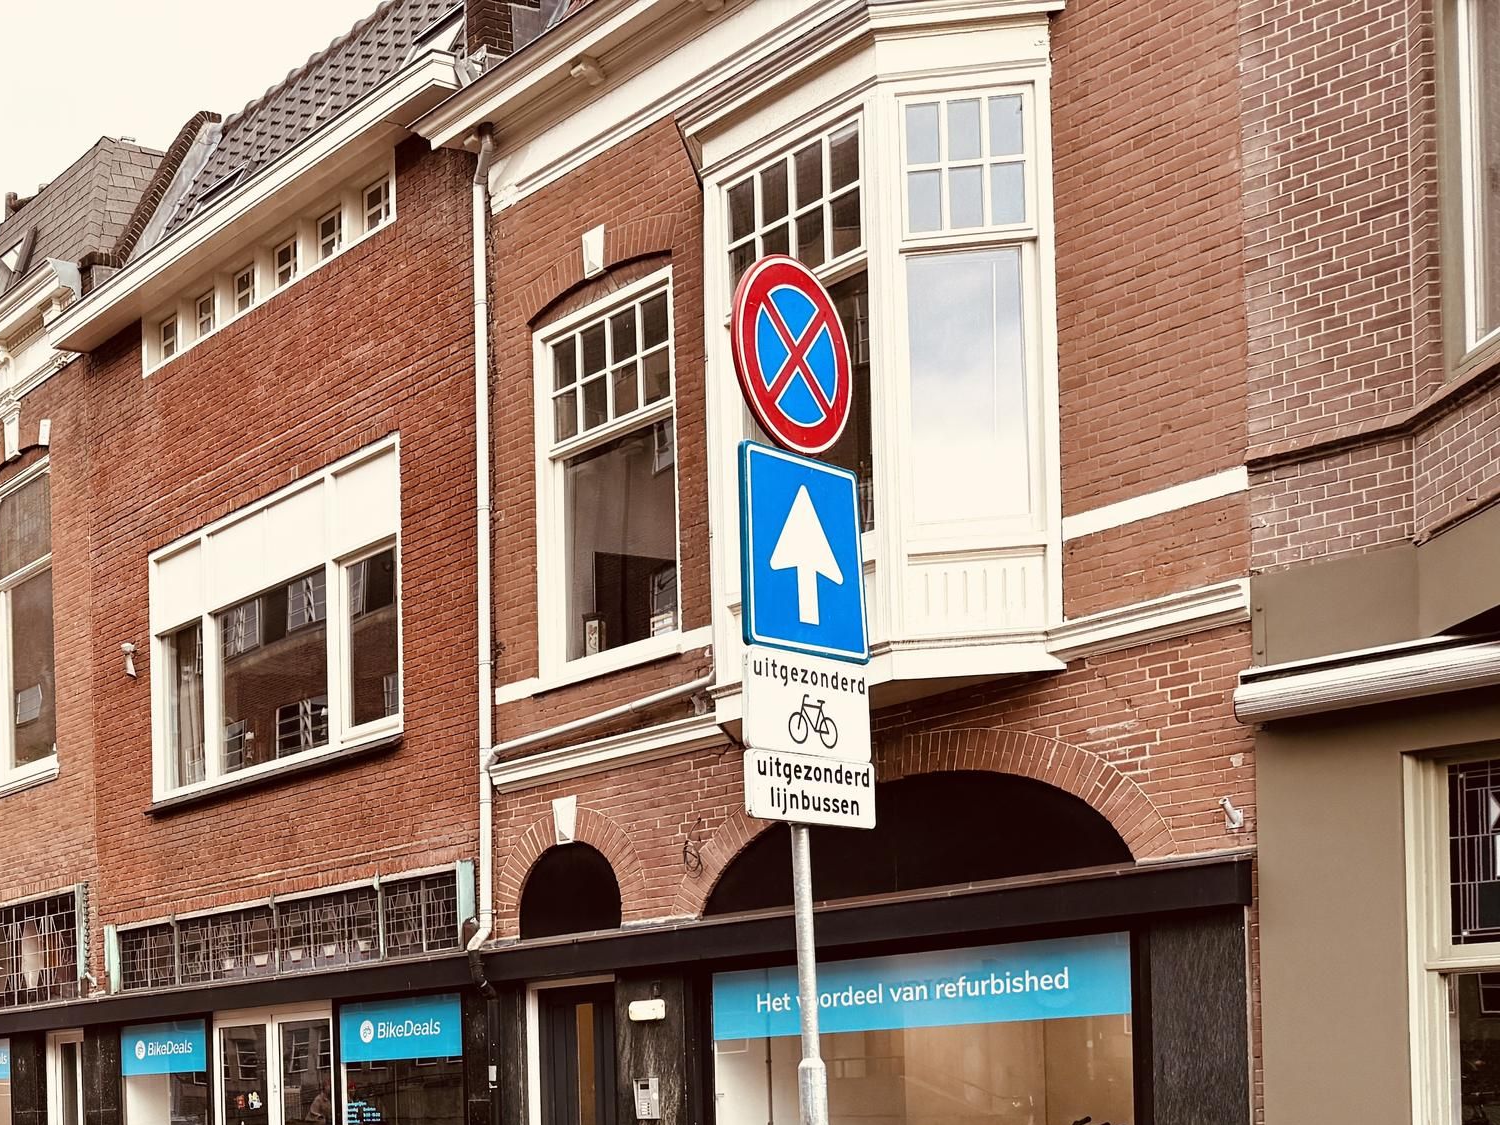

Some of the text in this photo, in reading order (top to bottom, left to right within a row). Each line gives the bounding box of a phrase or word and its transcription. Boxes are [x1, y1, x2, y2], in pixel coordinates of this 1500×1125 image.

[753, 658, 866, 695] uitgezonderd
[757, 756, 870, 788] uitgezonderd
[770, 786, 860, 816] lijnbussen
[756, 966, 1069, 1013] Het ordeel van refurbished
[377, 1017, 441, 1039] BikeDeals
[148, 1040, 193, 1056] BikeDeals
